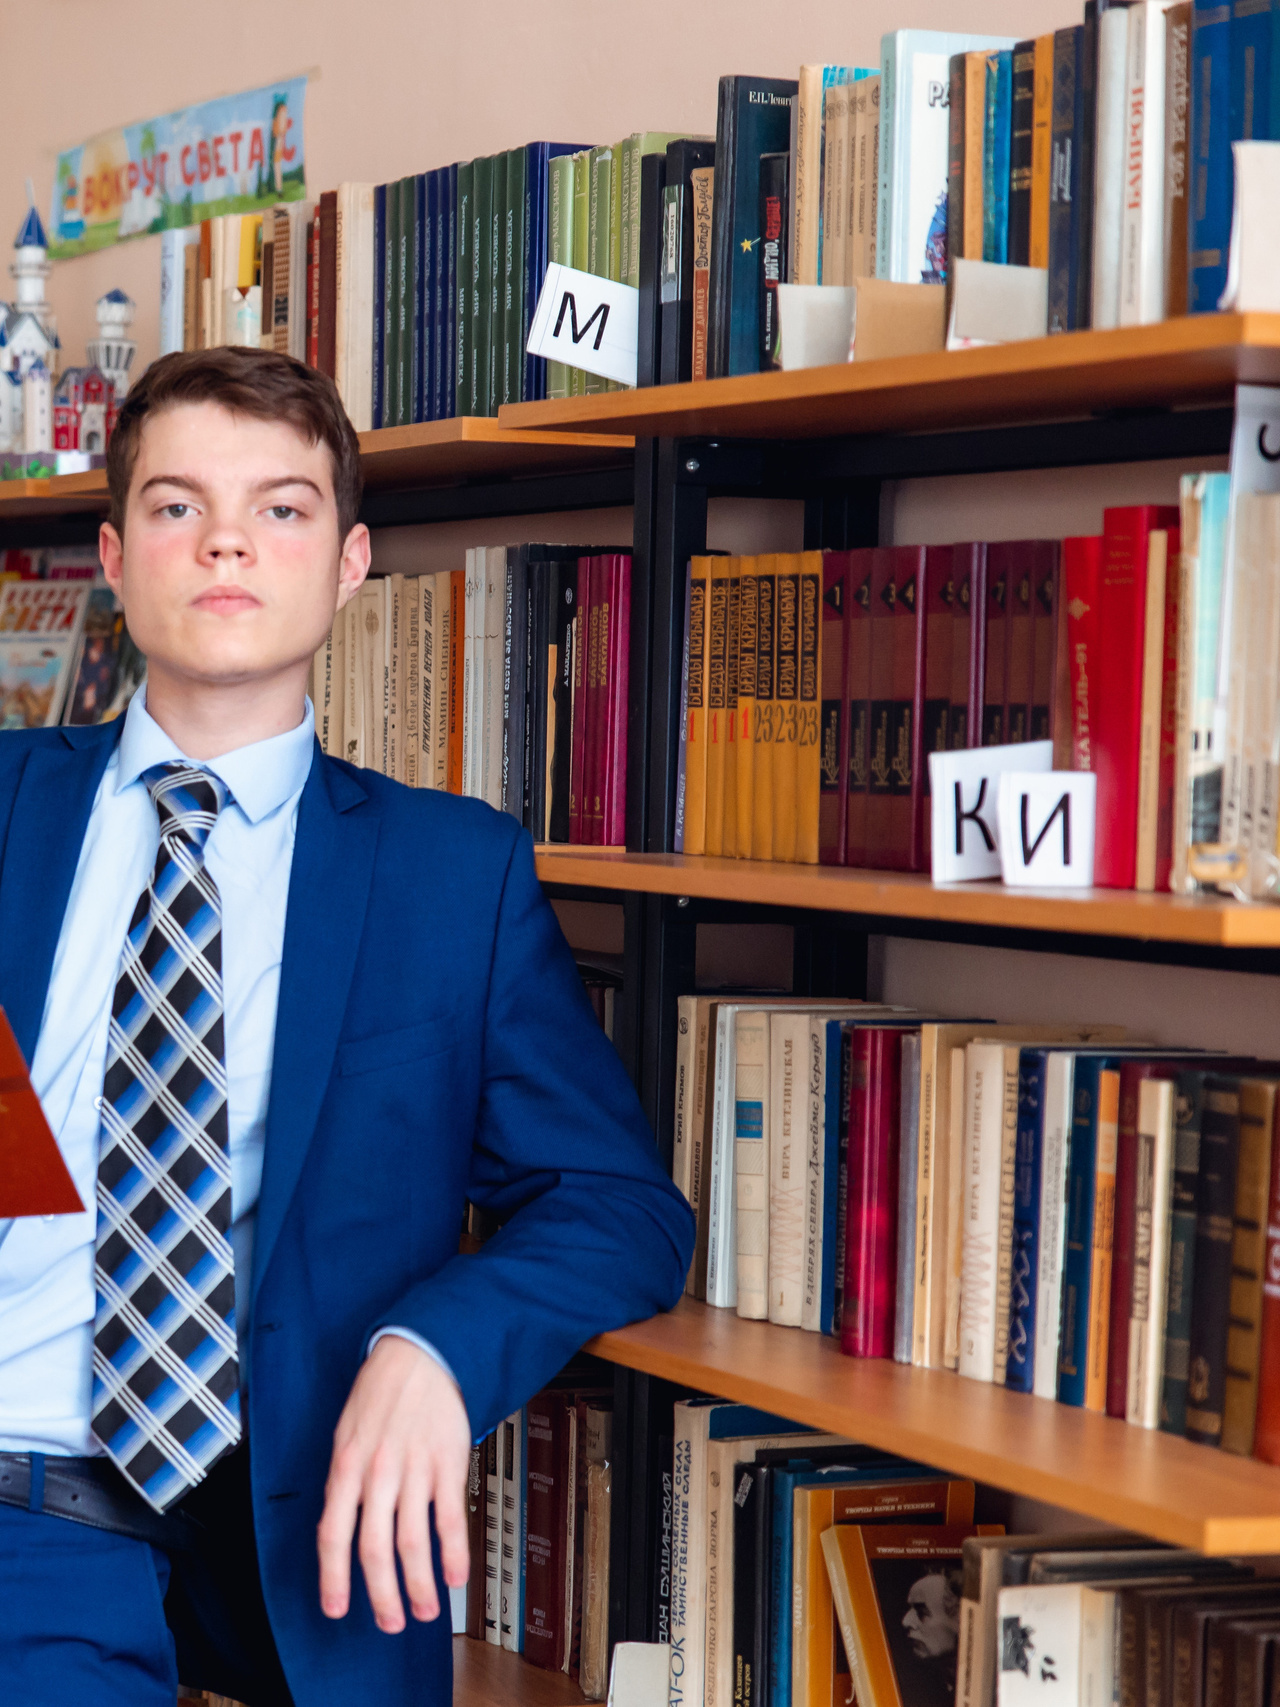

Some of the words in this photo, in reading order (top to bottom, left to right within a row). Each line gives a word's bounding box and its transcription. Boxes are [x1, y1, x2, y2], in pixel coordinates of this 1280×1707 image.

[180, 126, 266, 186] СВЕТА
[553, 170, 561, 238] МАКСИМОВ
[591, 161, 600, 230] МАКСИМОВ
[621, 151, 630, 222] МАКСИМОВ
[630, 147, 640, 219] МАКСИМОВ
[858, 183, 866, 234] АНТОНИНА
[473, 218, 481, 283] ЧЕЛОВЕКА
[506, 210, 514, 275] ЧЕЛОВЕКА
[620, 226, 630, 278] Владимир
[629, 222, 640, 275] Владимир
[696, 221, 711, 268] Доктор
[553, 291, 610, 350] М
[694, 330, 705, 376] ВЛАДИМИР
[423, 589, 433, 627] ХОЛЬТА
[741, 577, 758, 649] КЕРБАБАЕВ
[835, 585, 840, 606] 1
[861, 585, 870, 606] 2
[888, 583, 897, 604] 3
[904, 583, 915, 604] 4
[960, 582, 970, 604] 6
[995, 581, 1005, 604] 7
[1019, 580, 1029, 601] 8
[392, 591, 401, 649] погибнуть
[689, 586, 703, 656] КЕРБАБАЕВ
[710, 586, 727, 656] КЕРБАБАЕВ
[760, 580, 773, 651] КЕРБАБАЕВ
[781, 580, 797, 651] КЕРБАБАЕВ
[802, 580, 819, 652] КЕРБАБАЕВ
[391, 654, 399, 673] ему
[423, 631, 433, 674] ВЕРНЕРА
[504, 639, 512, 653] ЗА
[564, 623, 572, 676] МАКАРЕНКО
[576, 605, 584, 688] БАКЛАНОВ
[589, 605, 599, 688] БАКЛАНОВ
[599, 602, 609, 686] БАКЛАНОВ
[324, 653, 332, 708] ЧЕТЫРЕ
[405, 652, 419, 697] мудрого
[438, 609, 450, 749] МАМИН-СИБИРЯК
[450, 641, 458, 735] ИСТОРИЧЕСКИЕ
[503, 656, 511, 691] ОХОТА
[564, 679, 571, 687] А.
[689, 659, 702, 705] БЕРДЫ
[710, 659, 725, 707] БЕРДЫ
[741, 653, 755, 693] БЕРДЫ
[759, 655, 771, 696] БЕРДЫ
[780, 656, 795, 697] БЕРДЫ
[803, 656, 817, 698] БЕРДЫ
[390, 702, 397, 715] Не
[404, 698, 418, 739] Звезды
[421, 677, 432, 755] ПРИКЛЮЧЕНИЯ
[502, 693, 510, 719] МОЯ
[688, 711, 695, 742] 1
[711, 711, 718, 743] 1
[728, 711, 735, 742] 1
[741, 706, 750, 739] 1
[1075, 642, 1092, 769] КАТЕЛЬ-91
[437, 756, 446, 771] Н.
[593, 796, 601, 811] 3
[953, 777, 996, 856] К
[1019, 792, 1071, 867] И
[699, 1024, 708, 1044] ЧАС
[677, 1064, 686, 1110] КРЫМОВ
[696, 1049, 708, 1115] РЕШАЮЩИЙ
[782, 1039, 794, 1137] КЕТЛИНСКАЯ
[1004, 1069, 1018, 1131] СЫНЕ
[675, 1113, 683, 1144] ЮРИЙ
[806, 1100, 821, 1176] Джеймс
[971, 1071, 984, 1176] КЕТЛИНСКАЯ
[693, 1141, 702, 1202] КАРАСЛАВОВ
[781, 1143, 792, 1180] ВЕРА
[809, 1178, 819, 1233] СЕВЕРА
[970, 1183, 980, 1221] ВЕРА
[1000, 1152, 1014, 1253] ПОВЕСТЬ
[806, 1235, 817, 1294] ДЕБРЯХ
[777, 1290, 783, 1306] 1
[805, 1296, 814, 1306] В
[675, 1439, 685, 1486] СКАЛ
[681, 1439, 692, 1495] СЛЕДЫ
[673, 1492, 681, 1566] СОЛЕНЫХ
[845, 1506, 873, 1514] ТВОРЦЫ
[903, 1502, 936, 1510] ТЕХНИКИ
[660, 1471, 672, 1597] СУШИНСКИЙ
[709, 1510, 720, 1559] ЛОРКА
[876, 1546, 905, 1554] ТВОРЦЫ
[678, 1501, 689, 1628] ТАИНСТВЕННЫЕ
[485, 1592, 494, 1610] 4
[501, 1596, 508, 1614] 3
[671, 1574, 679, 1627] ЗЕМЛЯ
[708, 1564, 719, 1623] ГАРСИА
[658, 1605, 669, 1644] ДАН
[706, 1626, 718, 1706] ФЕДЕРИКО
[734, 1654, 744, 1701] Казанцев
[743, 1663, 753, 1698] остров
